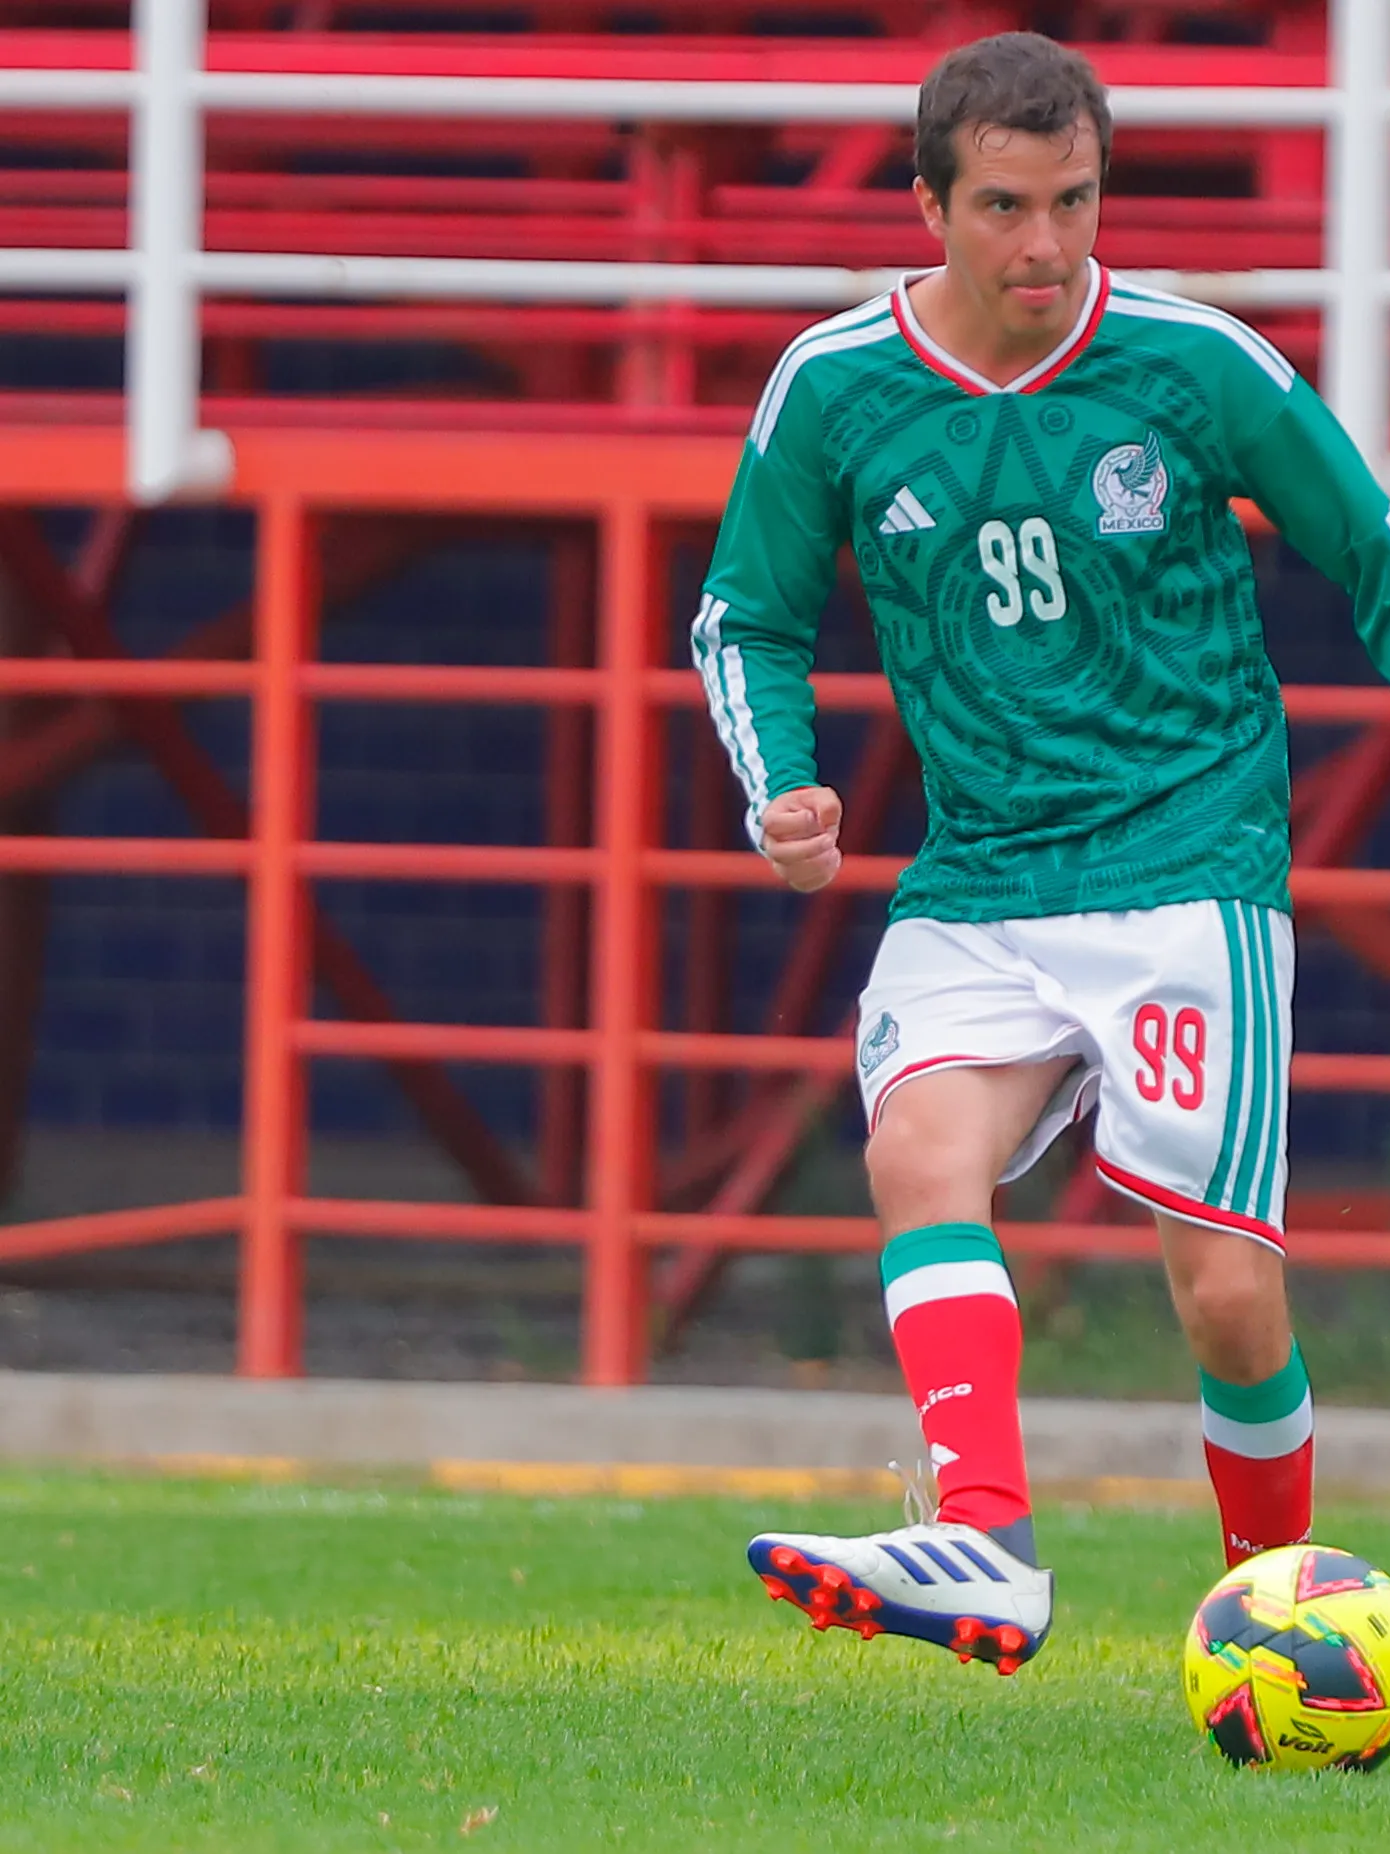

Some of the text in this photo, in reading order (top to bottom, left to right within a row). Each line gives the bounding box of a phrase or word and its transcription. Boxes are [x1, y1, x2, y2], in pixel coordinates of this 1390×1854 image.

[978, 516, 1067, 627] 99
[1132, 1002, 1206, 1111] 99
[1278, 1733, 1335, 1754] Voit
